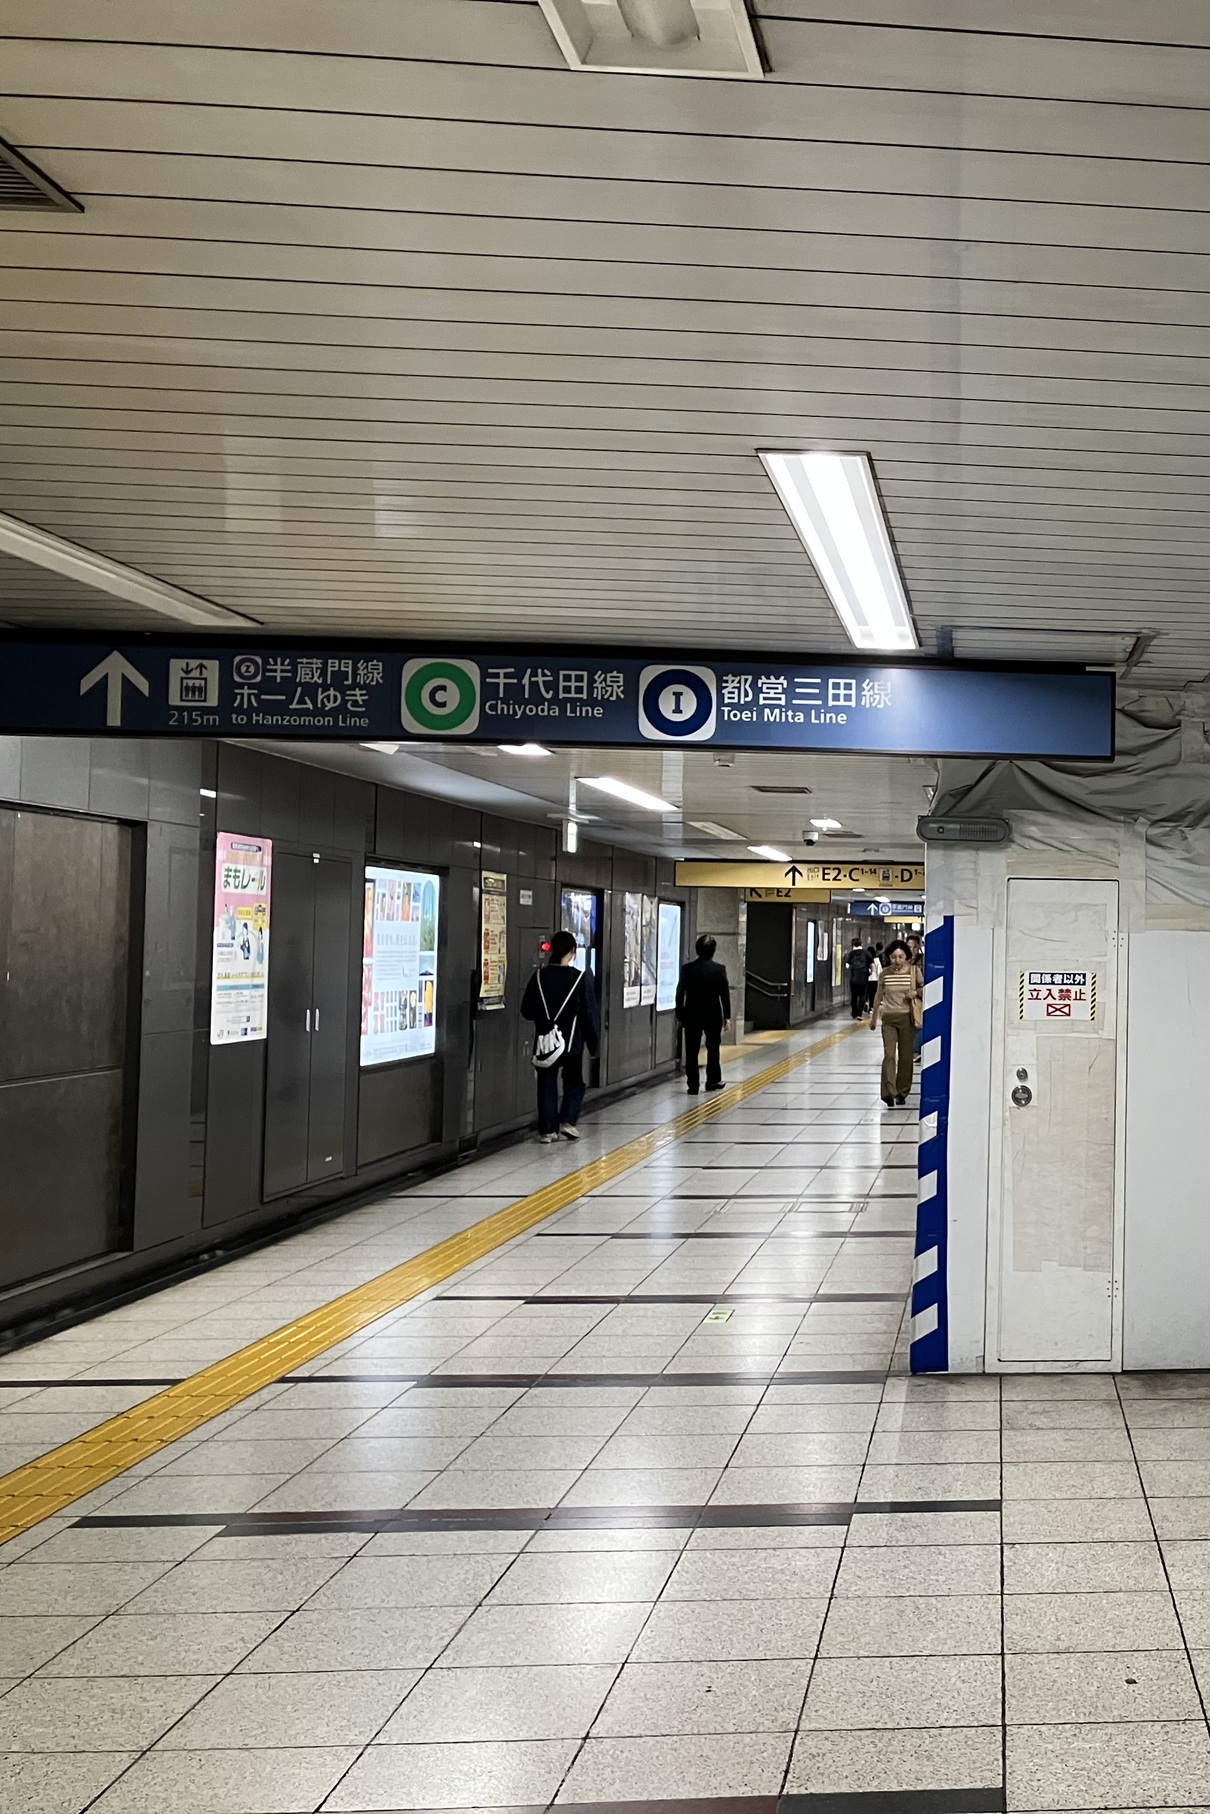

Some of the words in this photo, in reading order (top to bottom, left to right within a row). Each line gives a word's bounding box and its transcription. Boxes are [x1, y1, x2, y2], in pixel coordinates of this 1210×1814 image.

[265, 657, 383, 685] 半蔵門線
[485, 668, 625, 701] 千代田線
[721, 674, 892, 709] 都営三田線
[233, 686, 368, 711] ホームゆき
[428, 684, 448, 709] C
[672, 691, 683, 714] I
[168, 711, 219, 726] 215m
[231, 713, 247, 725] to
[252, 713, 333, 726] Hanzomon
[338, 714, 369, 727] Line
[485, 700, 559, 719] Chiyoda
[566, 703, 604, 717] Line
[721, 706, 757, 722] Toei
[763, 708, 804, 723] Mita
[811, 709, 847, 724] Line
[1030, 973, 1085, 985] 関係者以外
[1028, 988, 1087, 1001] 立入禁止
